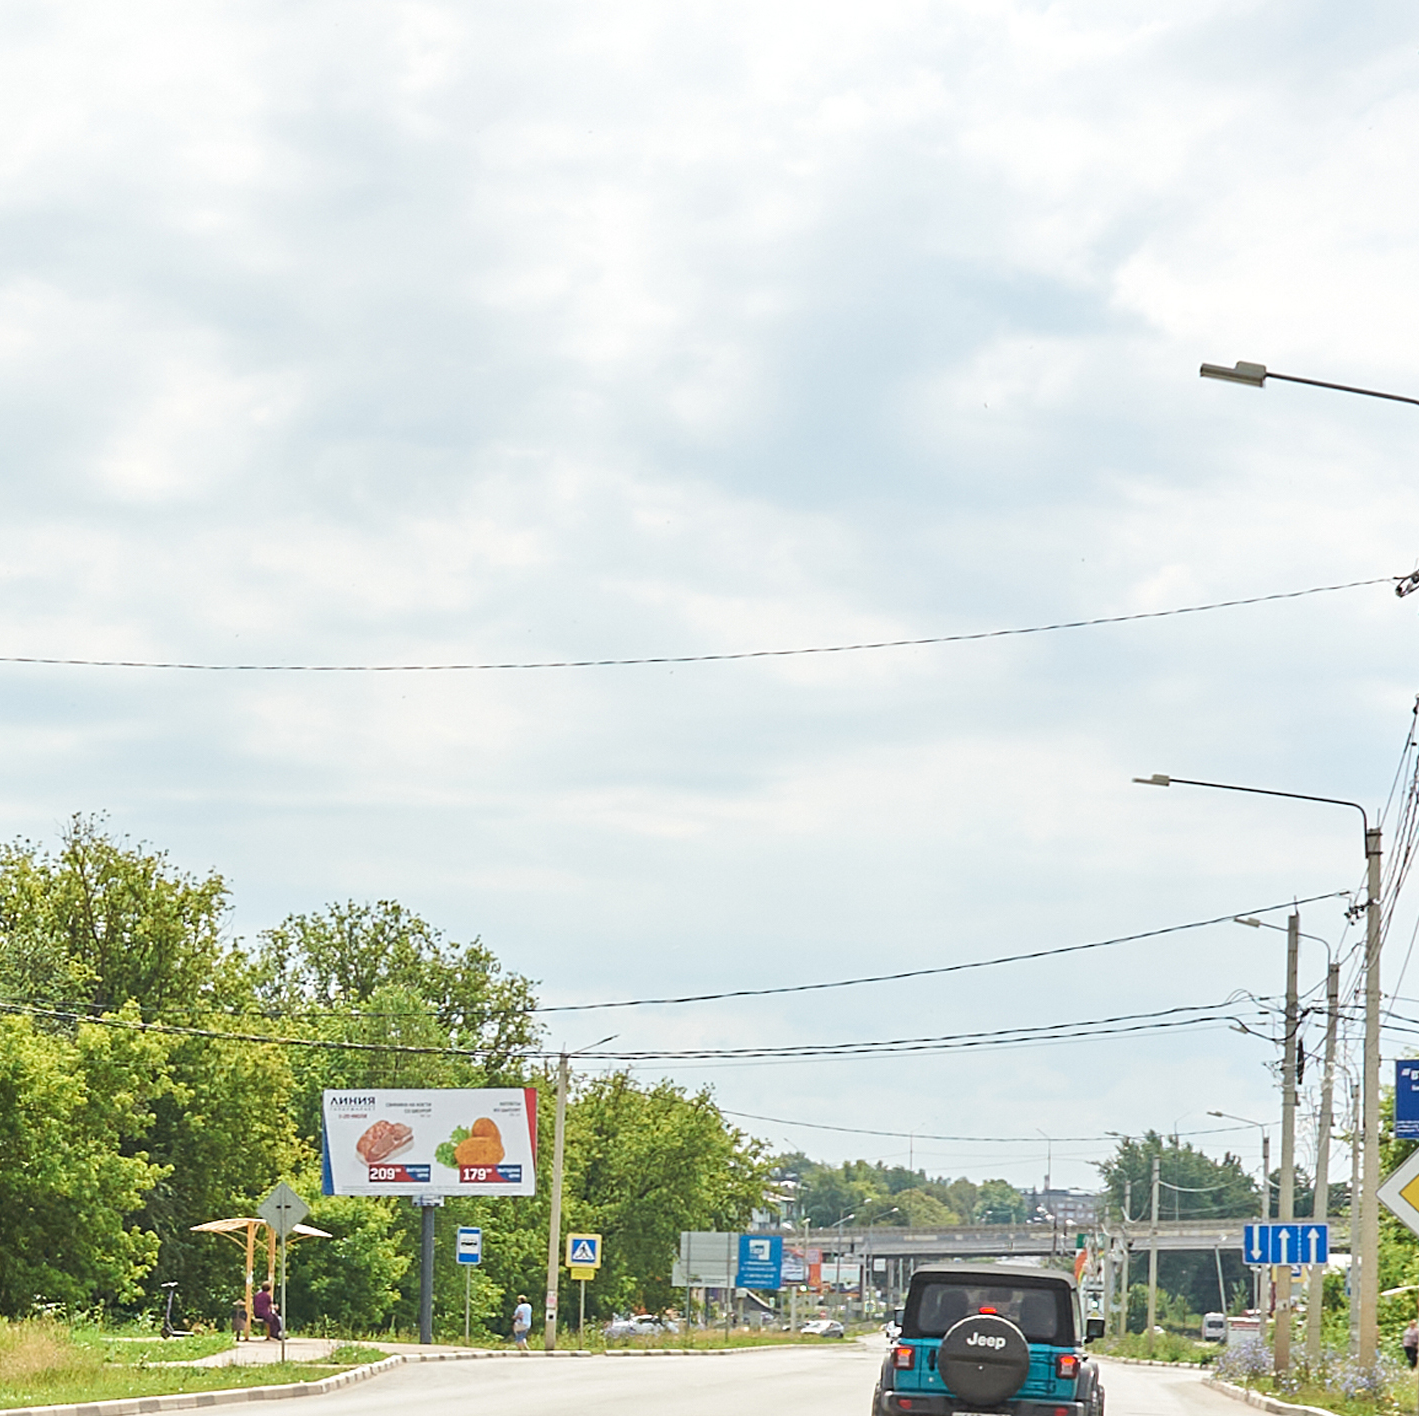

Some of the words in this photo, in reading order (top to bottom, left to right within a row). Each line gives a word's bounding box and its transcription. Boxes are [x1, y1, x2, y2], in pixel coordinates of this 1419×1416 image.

[330, 1097, 376, 1106] ЛИНИЯ
[369, 1167, 396, 1180] 209
[463, 1168, 487, 1181] 179
[966, 1332, 1006, 1350] Jeep
